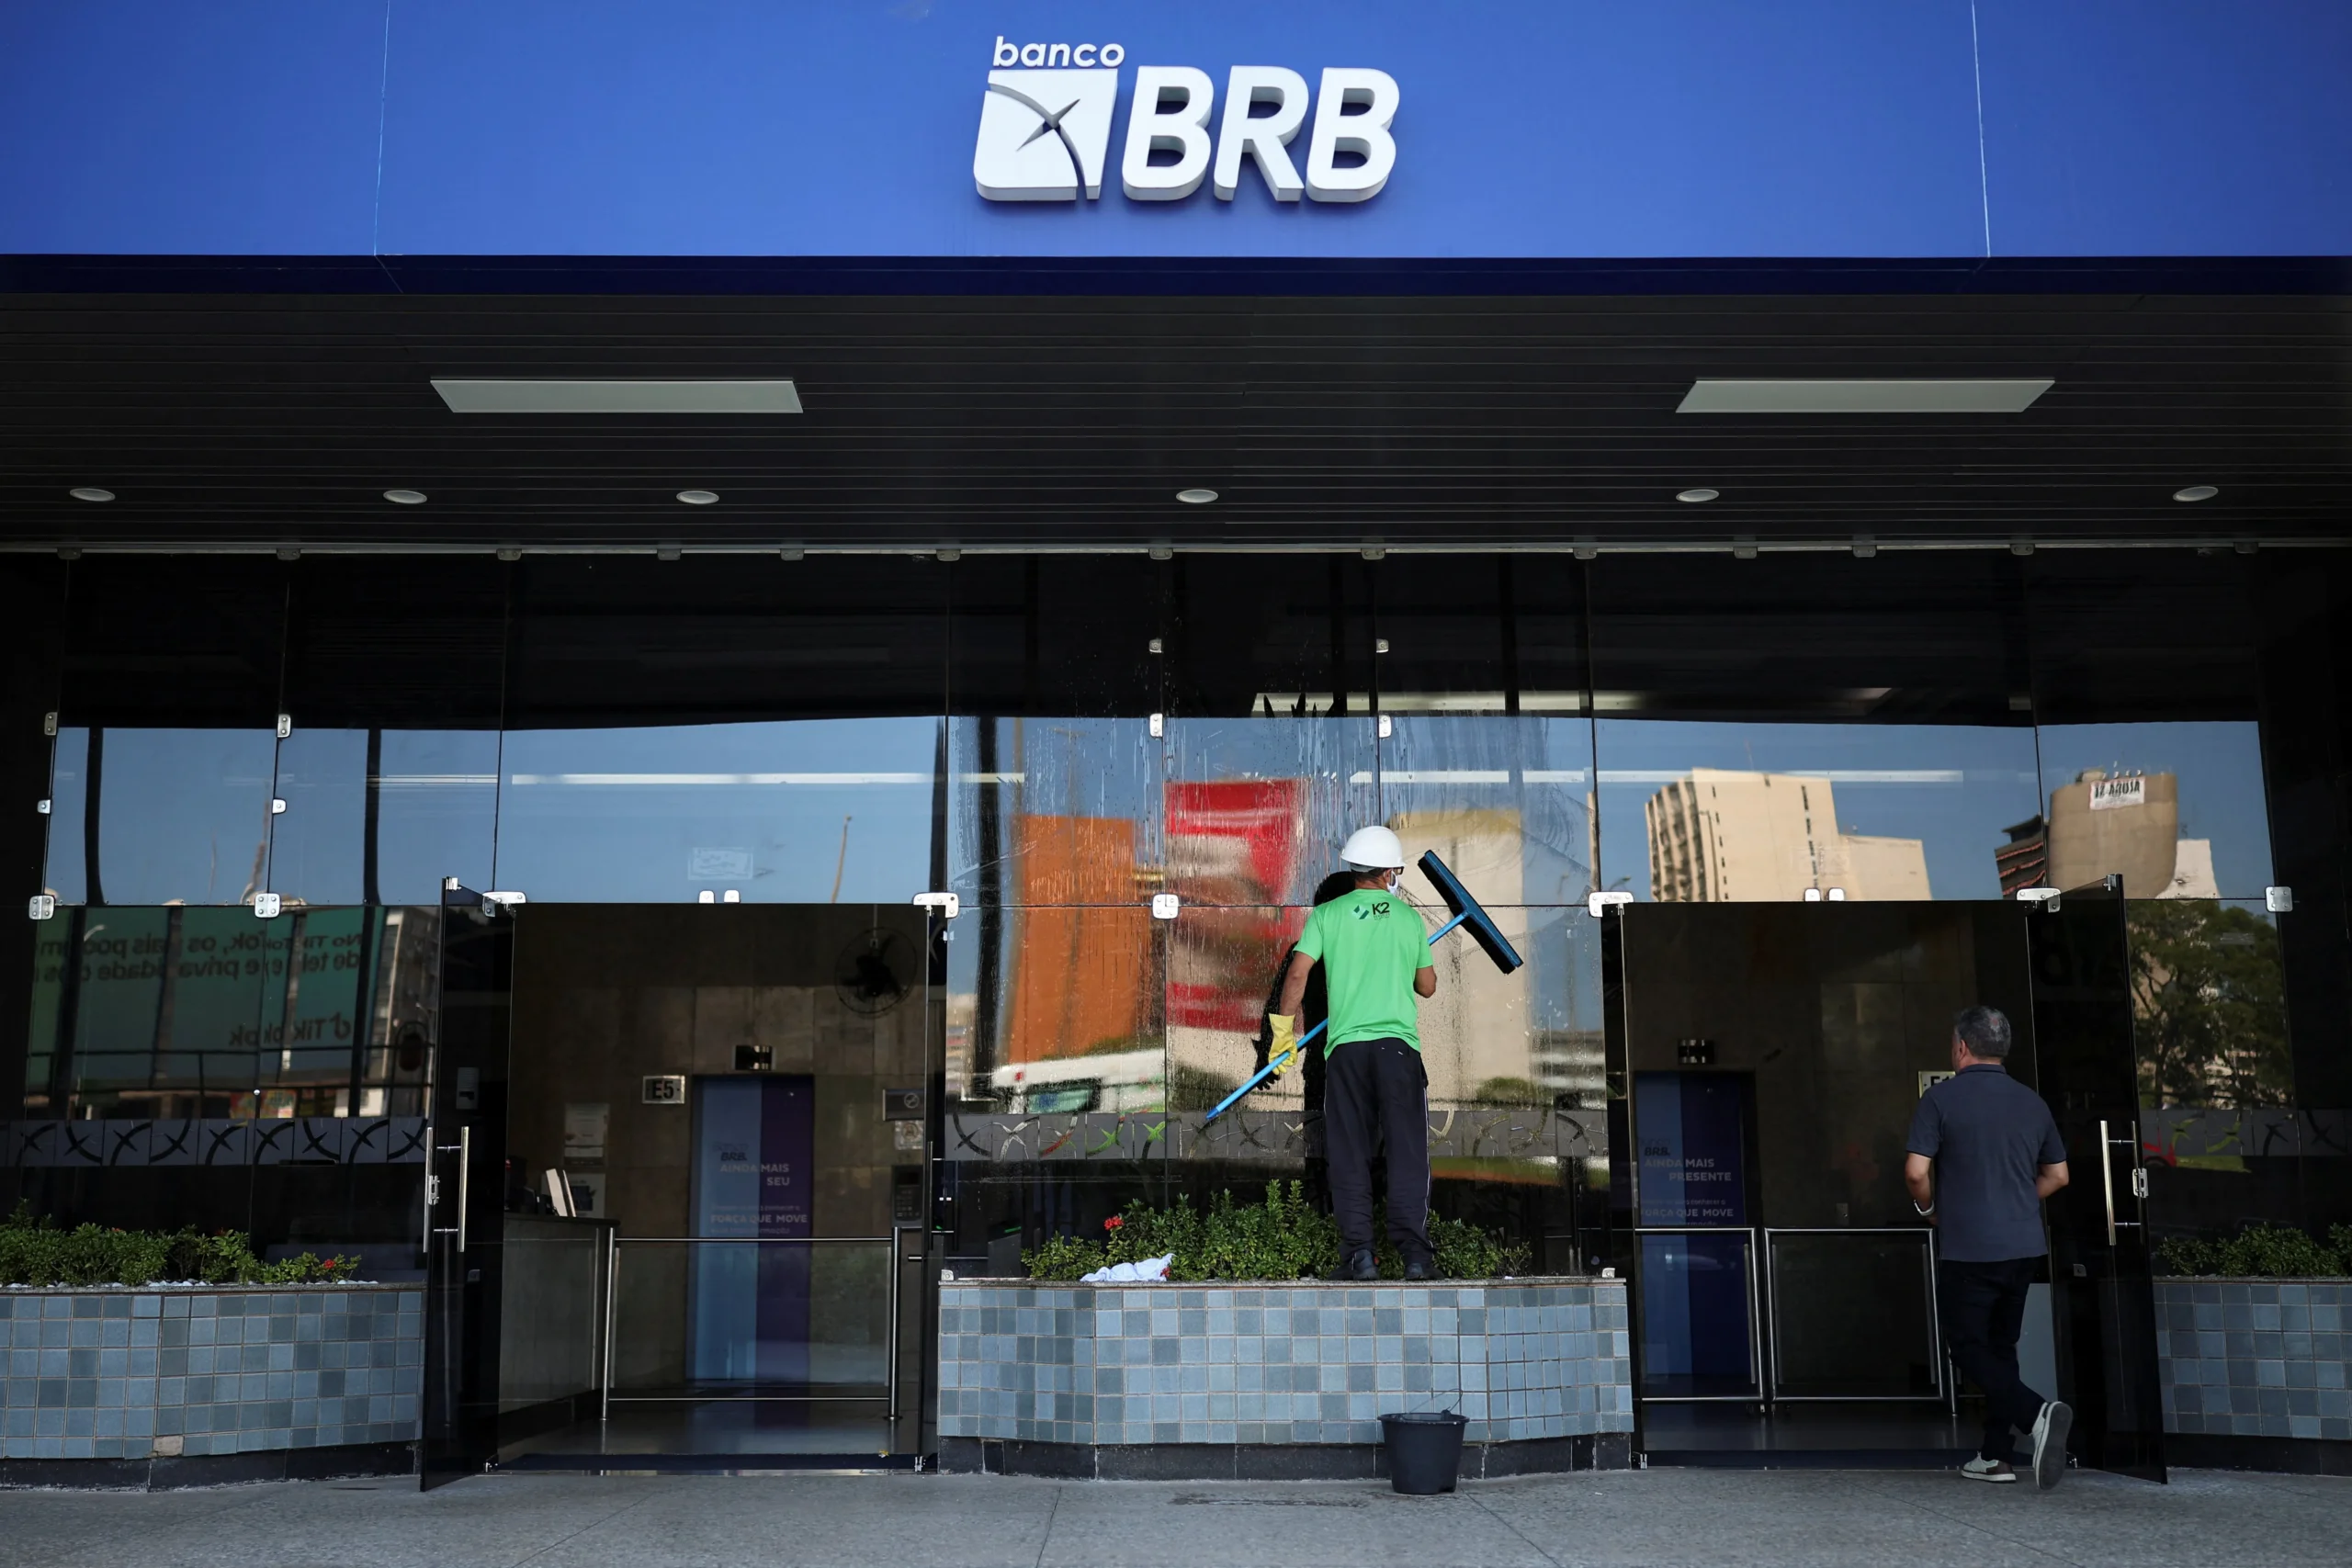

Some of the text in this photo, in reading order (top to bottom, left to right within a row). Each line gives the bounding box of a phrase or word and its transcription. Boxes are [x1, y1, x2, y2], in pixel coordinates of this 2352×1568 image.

[992, 35, 1125, 67] banco
[1122, 65, 1400, 201] BRB
[1372, 902, 1390, 915] K2
[652, 1080, 674, 1099] E5
[720, 1163, 790, 1173] AINDA MAIS
[1645, 1158, 1714, 1168] AINDA MAIS
[1668, 1172, 1732, 1181] PRESENTE
[766, 1177, 790, 1187] SEU
[1676, 1209, 1699, 1219] QUE
[1702, 1208, 1735, 1217] MOVE
[775, 1214, 808, 1224] MOVE
